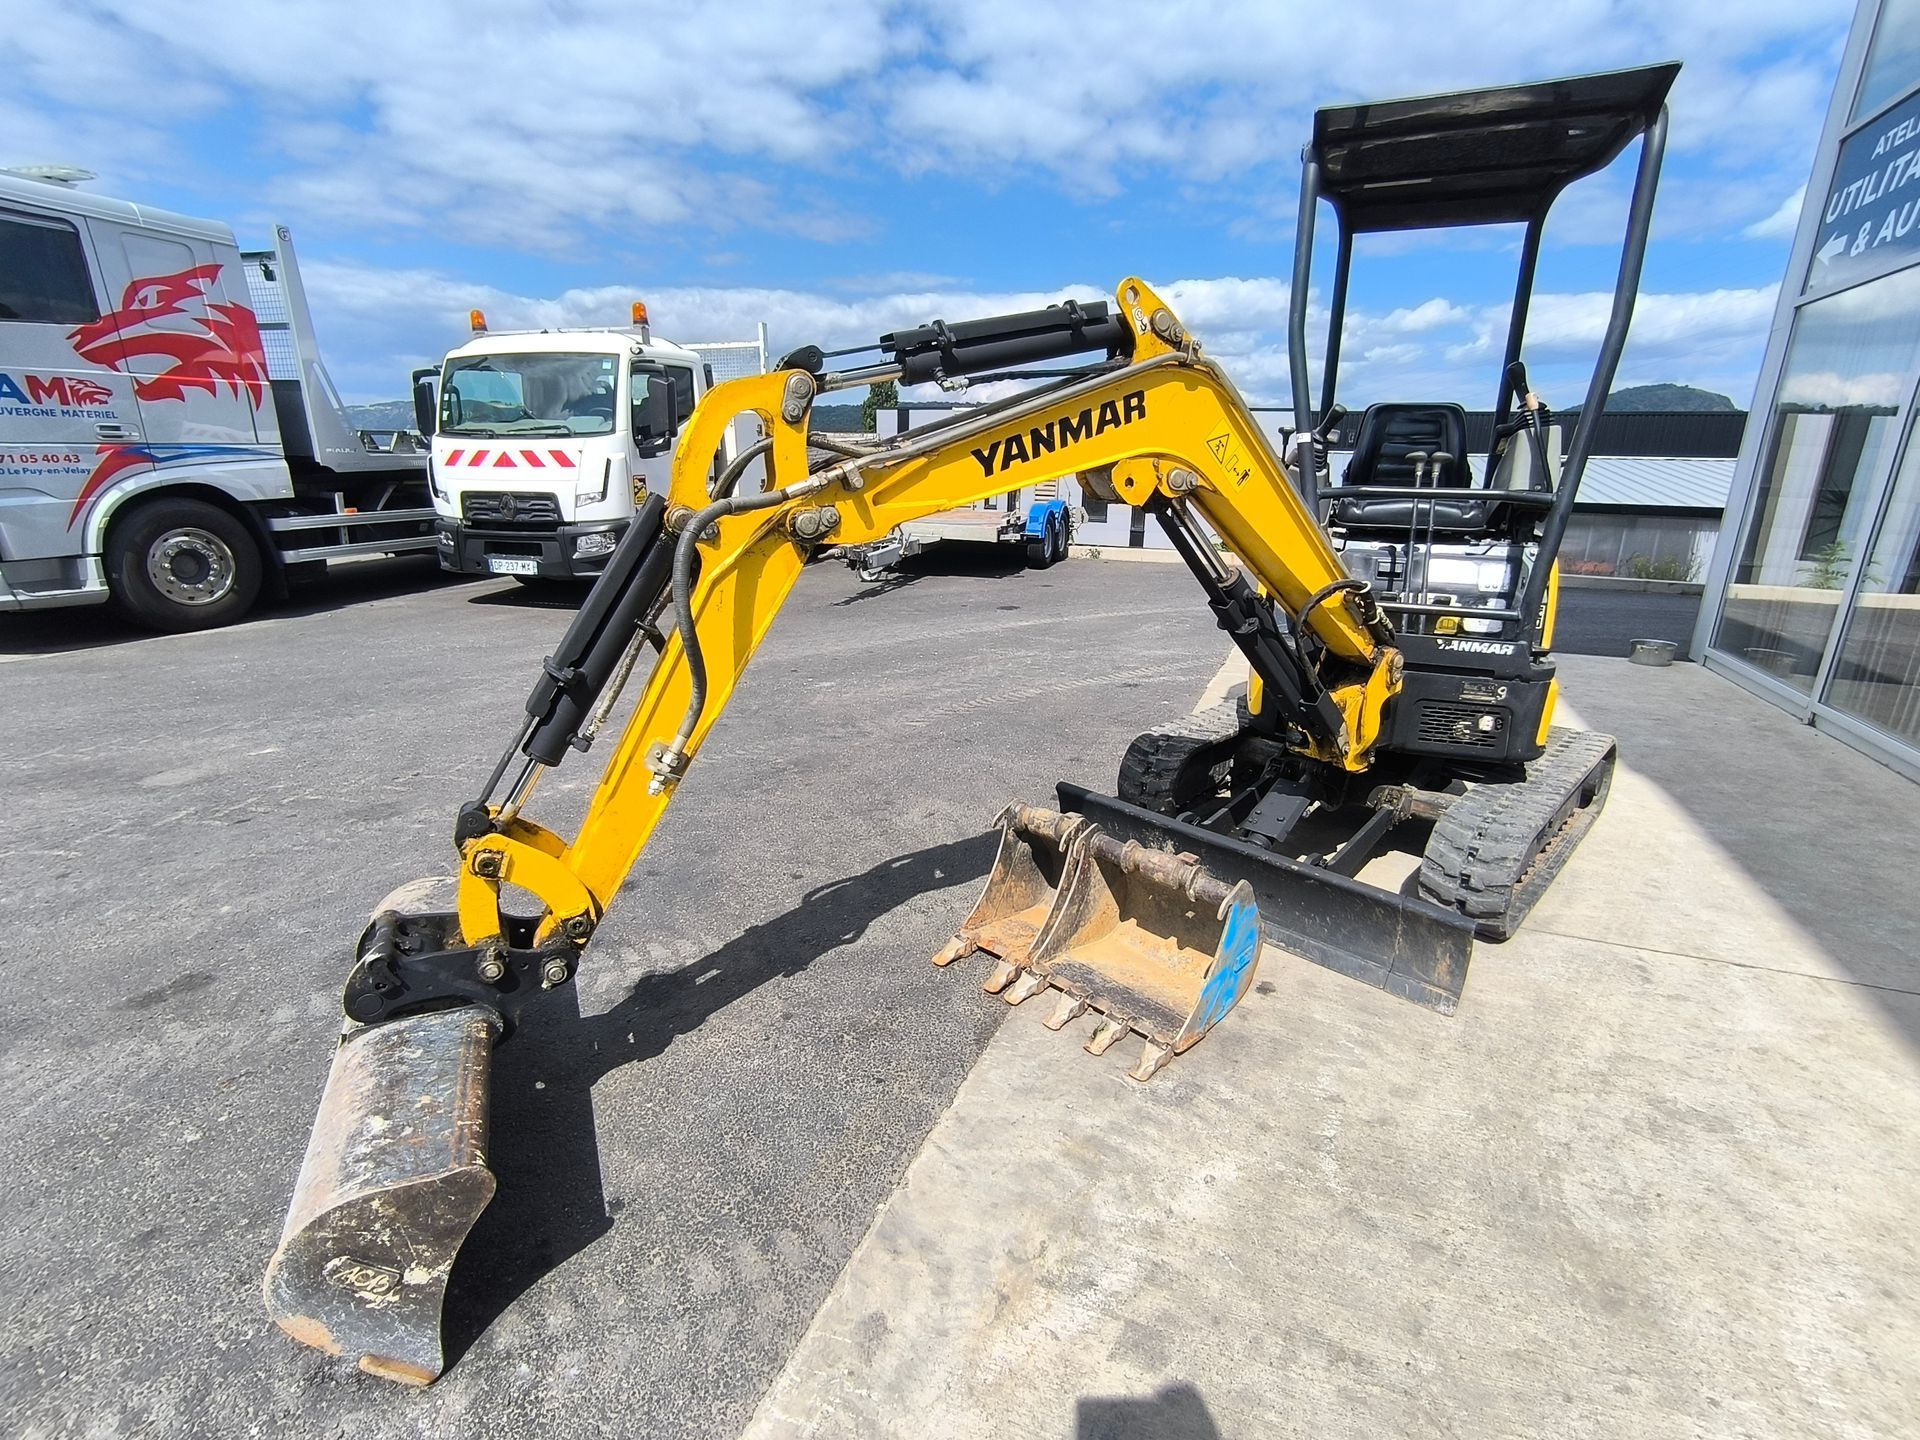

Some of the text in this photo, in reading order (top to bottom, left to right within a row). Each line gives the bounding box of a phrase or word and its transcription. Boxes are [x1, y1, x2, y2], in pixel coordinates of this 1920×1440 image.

[1850, 196, 1920, 257] & AU
[0, 373, 71, 406] AM
[61, 409, 118, 419] MATERIEL
[970, 390, 1146, 478] YANMAR
[20, 454, 38, 464] 05
[41, 454, 59, 464] 40
[63, 454, 80, 464] 43
[23, 467, 91, 476] Puy-en-Velay
[1436, 639, 1515, 656] YANMAR
